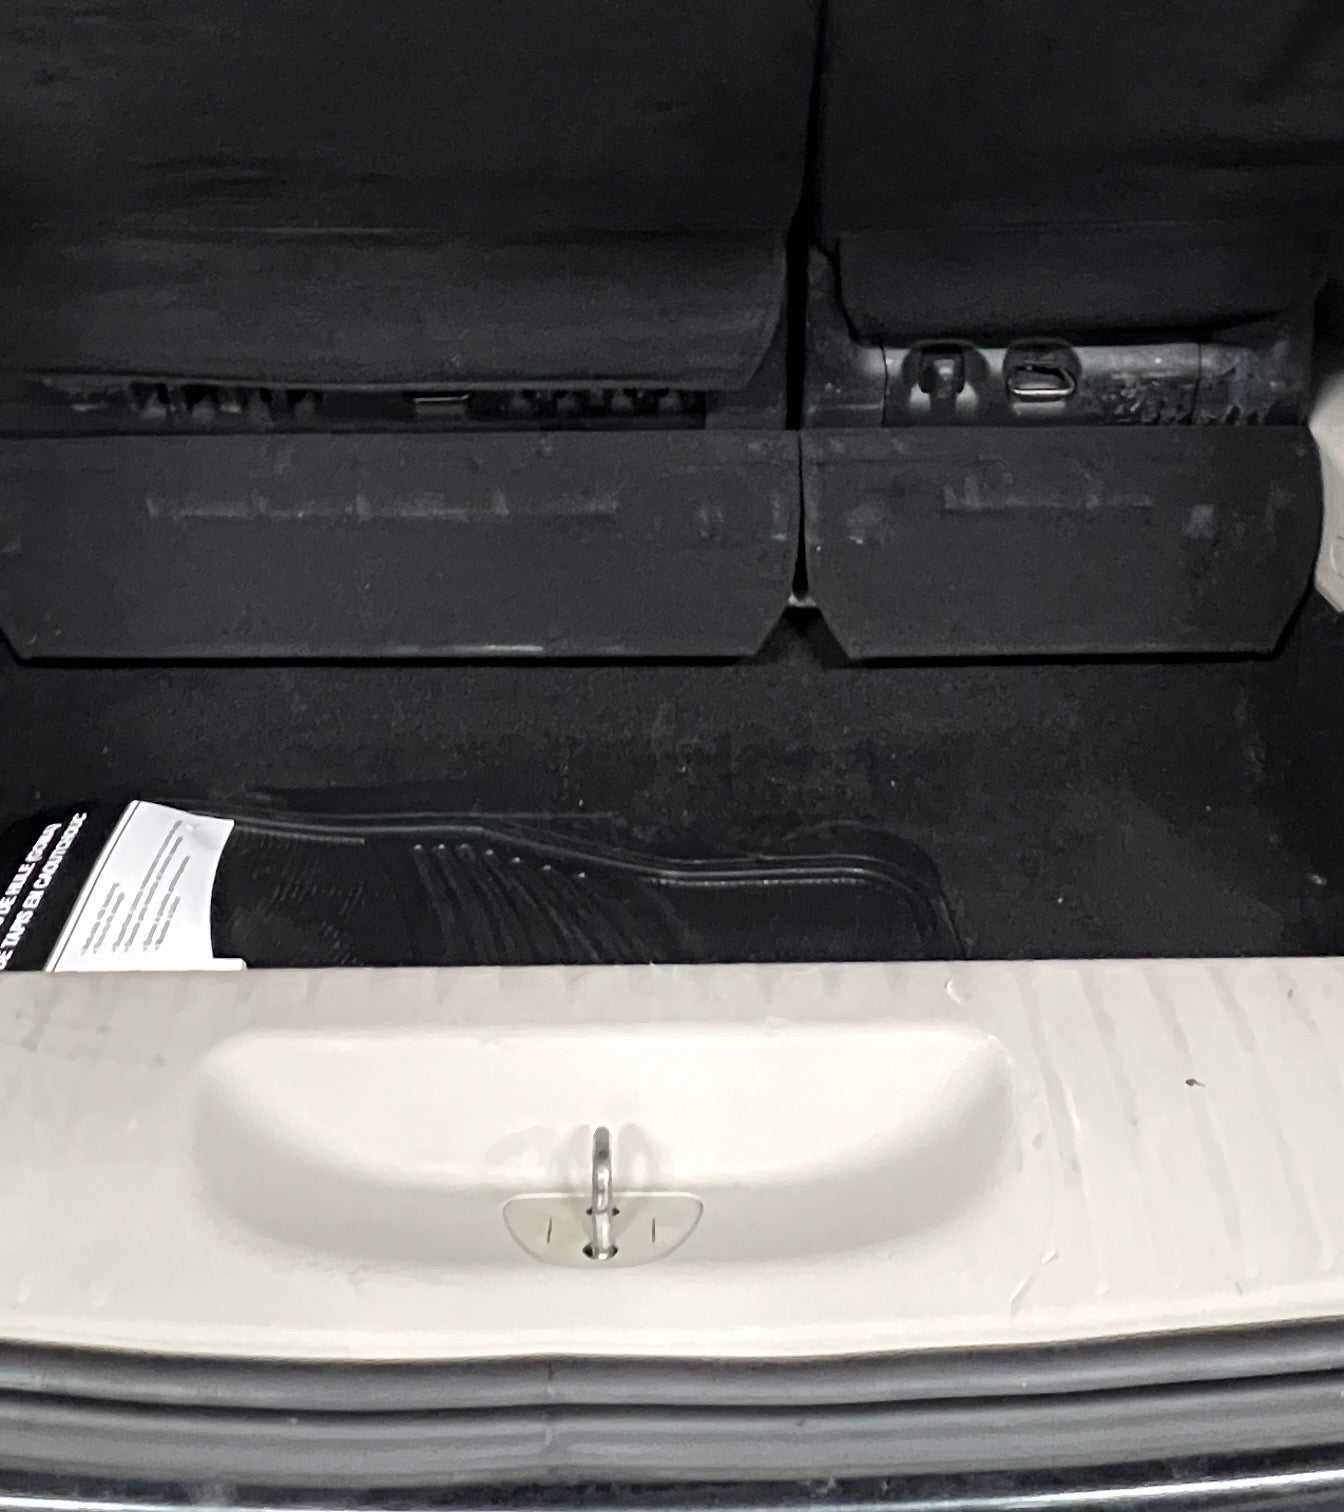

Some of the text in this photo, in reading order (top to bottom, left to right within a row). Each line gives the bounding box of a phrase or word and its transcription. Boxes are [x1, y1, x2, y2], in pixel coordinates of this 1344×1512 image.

[4, 862, 36, 896] HULE
[0, 910, 34, 949] TAPIS
[22, 889, 45, 909] EN
